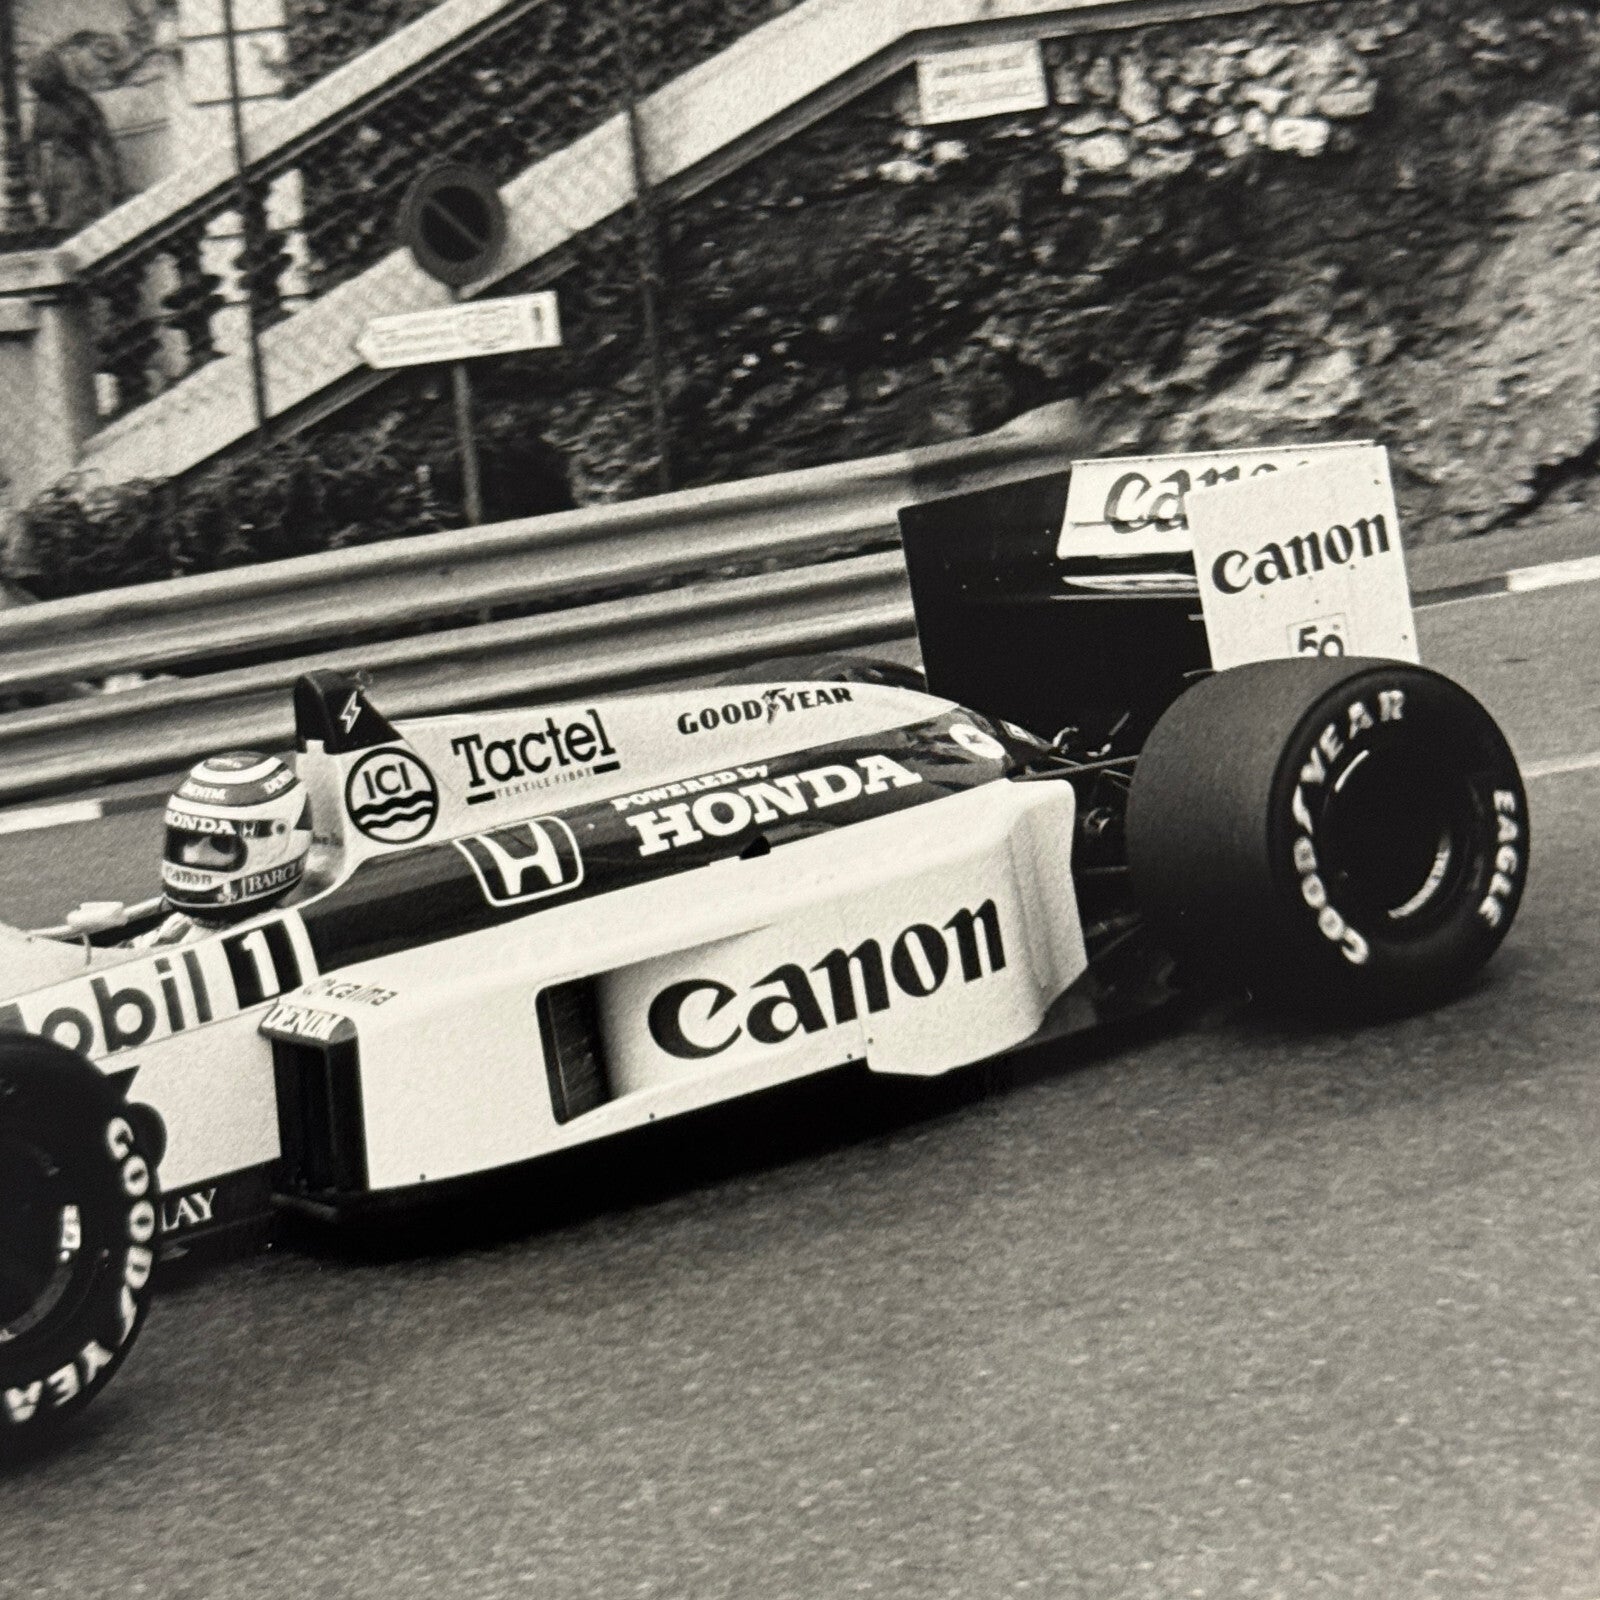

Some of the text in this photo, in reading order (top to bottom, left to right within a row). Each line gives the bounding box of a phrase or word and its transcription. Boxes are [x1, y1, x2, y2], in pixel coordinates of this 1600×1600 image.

[1211, 513, 1391, 595] Canon
[363, 761, 412, 800] ICI
[450, 708, 617, 788] Tactel
[611, 770, 738, 811] POWERED
[625, 753, 923, 857] HONDA
[0, 928, 281, 1056] obil 1
[647, 898, 1007, 1060] Canon
[261, 1001, 347, 1042] DENIM
